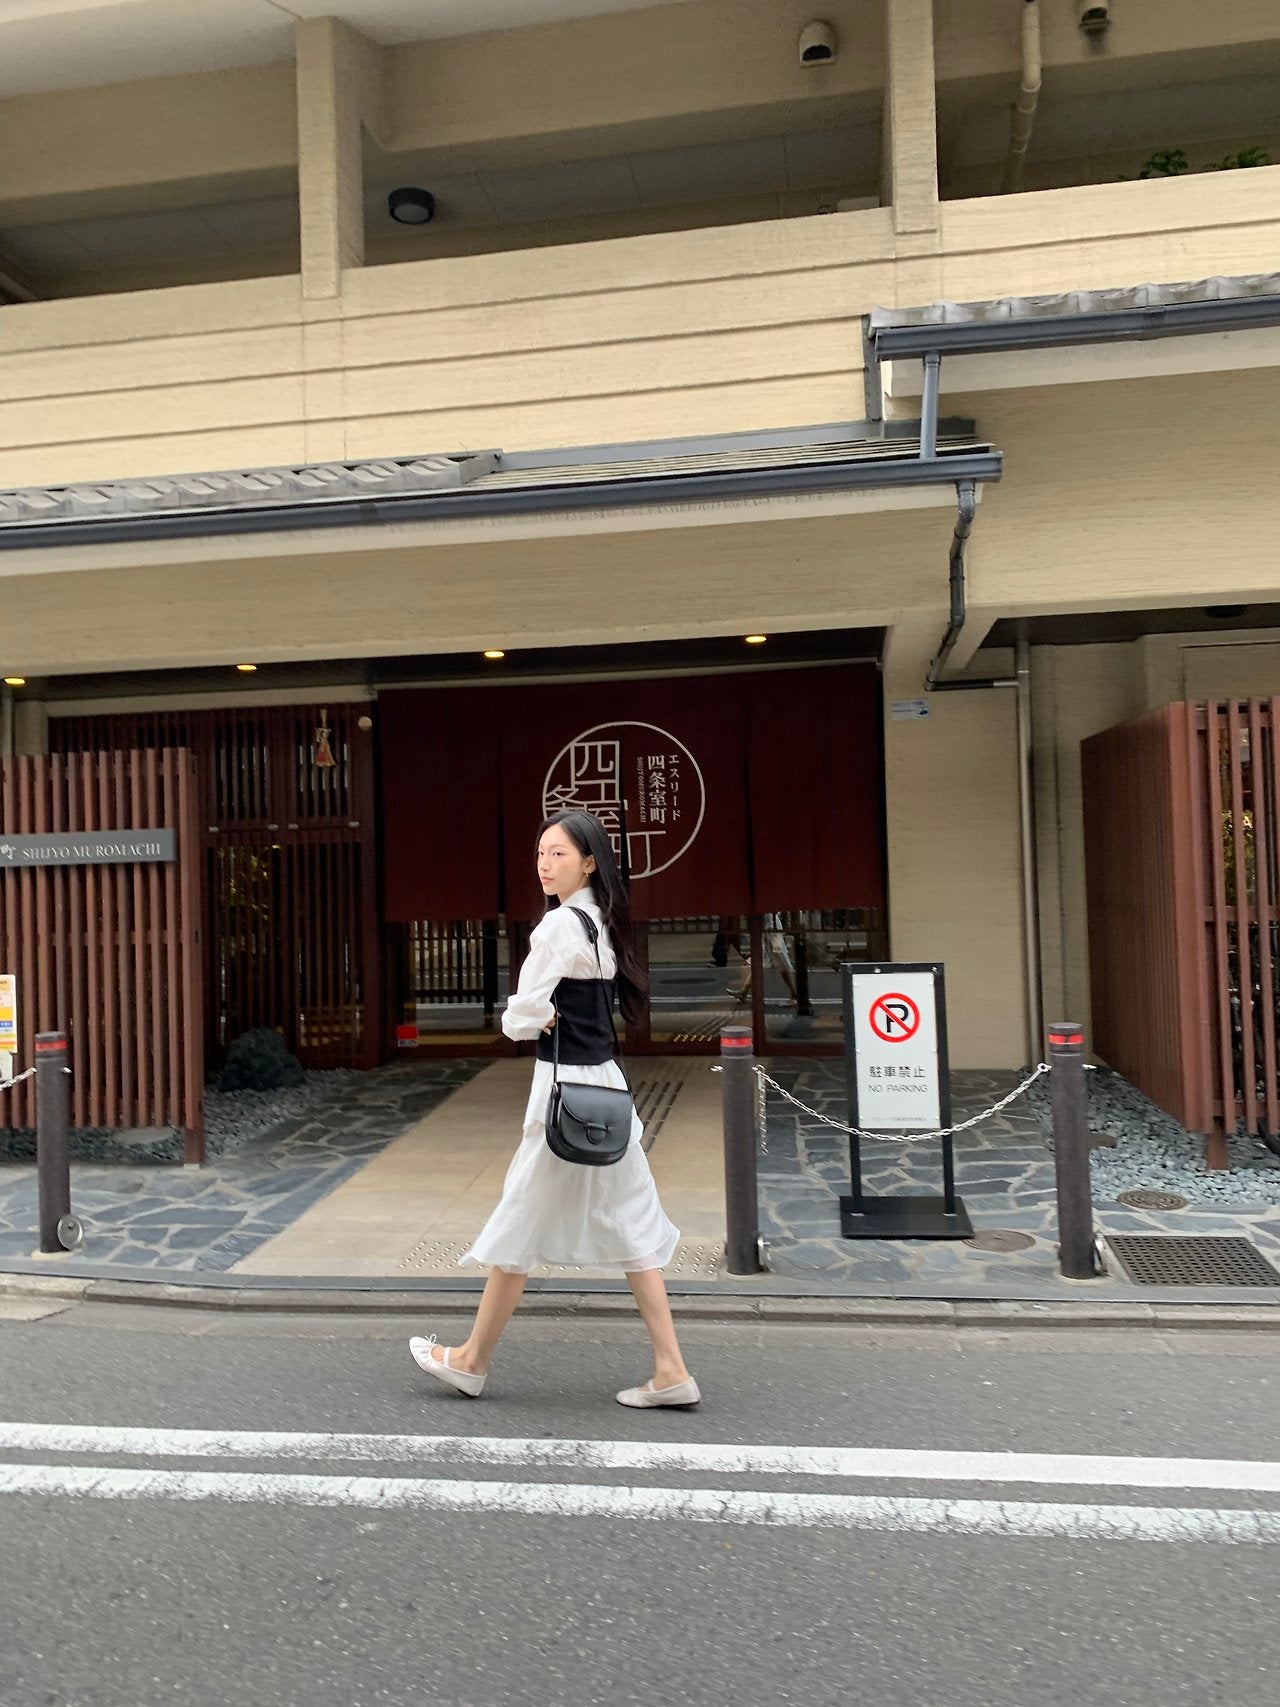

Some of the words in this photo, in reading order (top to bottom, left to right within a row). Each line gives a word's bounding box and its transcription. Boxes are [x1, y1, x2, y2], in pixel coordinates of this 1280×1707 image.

[647, 754, 667, 824] 四条室町
[668, 754, 681, 822] エスリード
[885, 1003, 909, 1033] P
[869, 1065, 925, 1078] 駐車禁止
[868, 1084, 882, 1093] NO
[887, 1084, 928, 1093] PARKING
